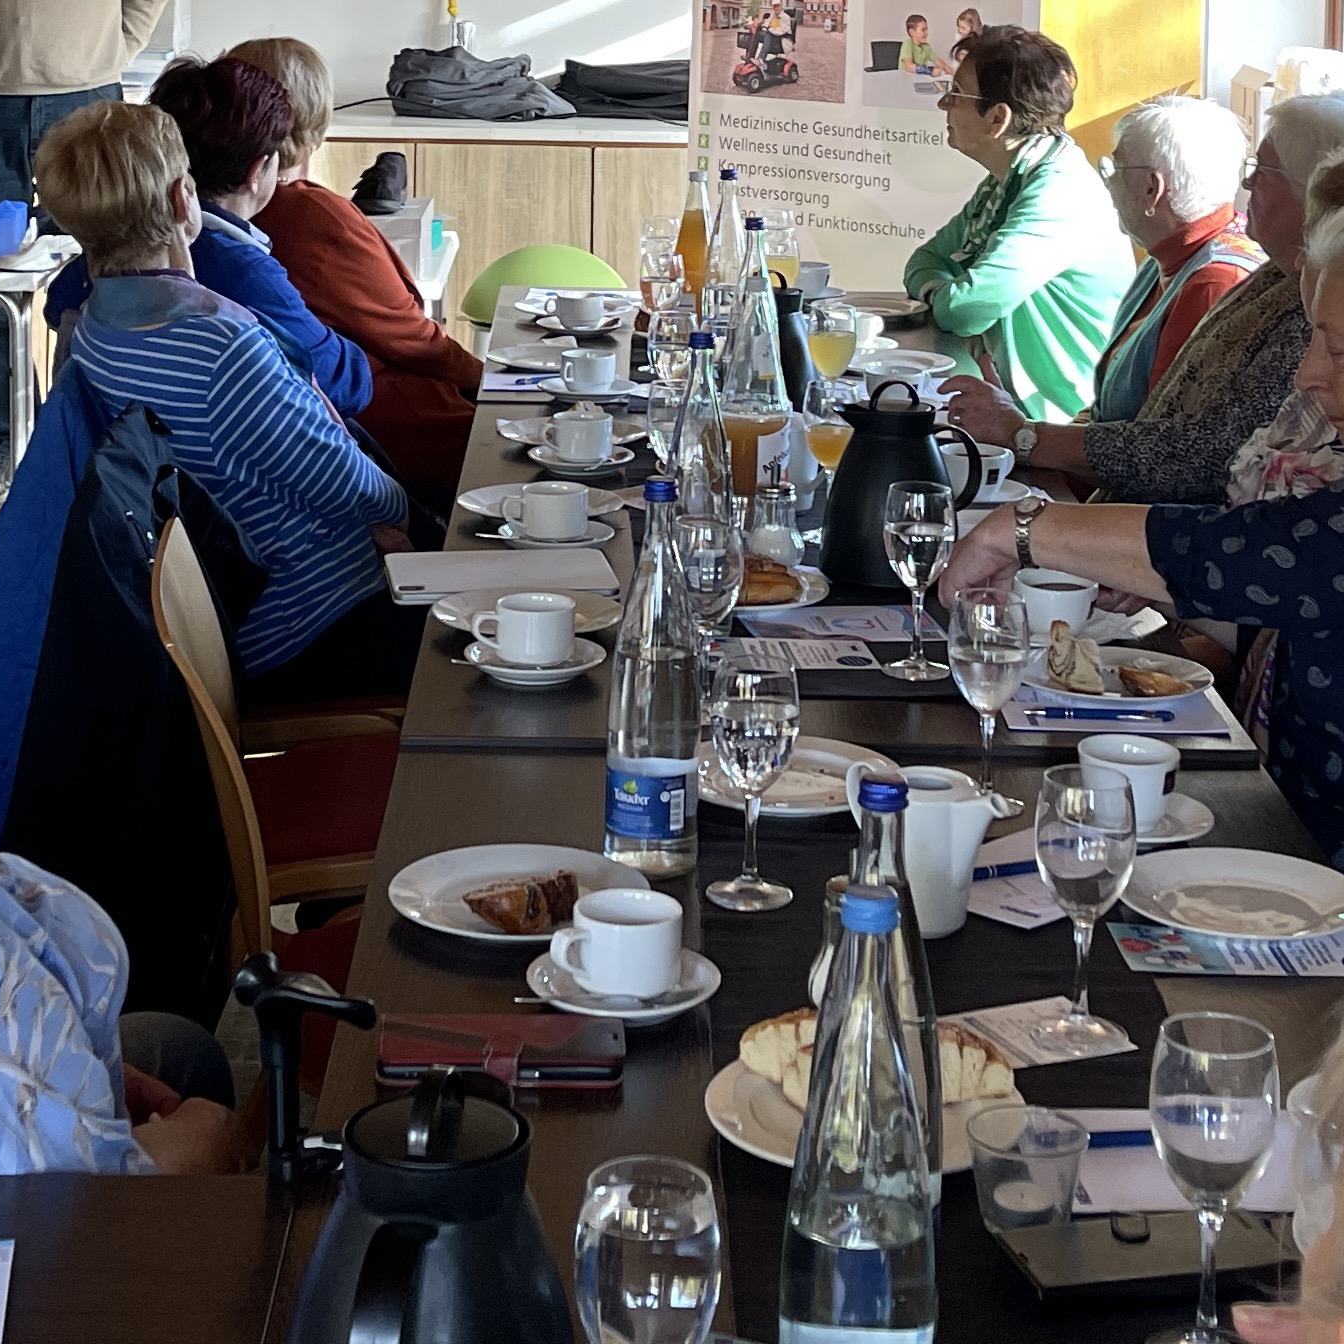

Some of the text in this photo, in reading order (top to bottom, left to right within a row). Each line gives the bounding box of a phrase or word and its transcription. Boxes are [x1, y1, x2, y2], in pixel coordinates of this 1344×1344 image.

[719, 113, 944, 146] Medizinische Gesundheitsartikel
[718, 135, 892, 166] Wellness und Gesundheit
[717, 180, 830, 208] stversorgung
[807, 213, 926, 240] Funktionsschuhe
